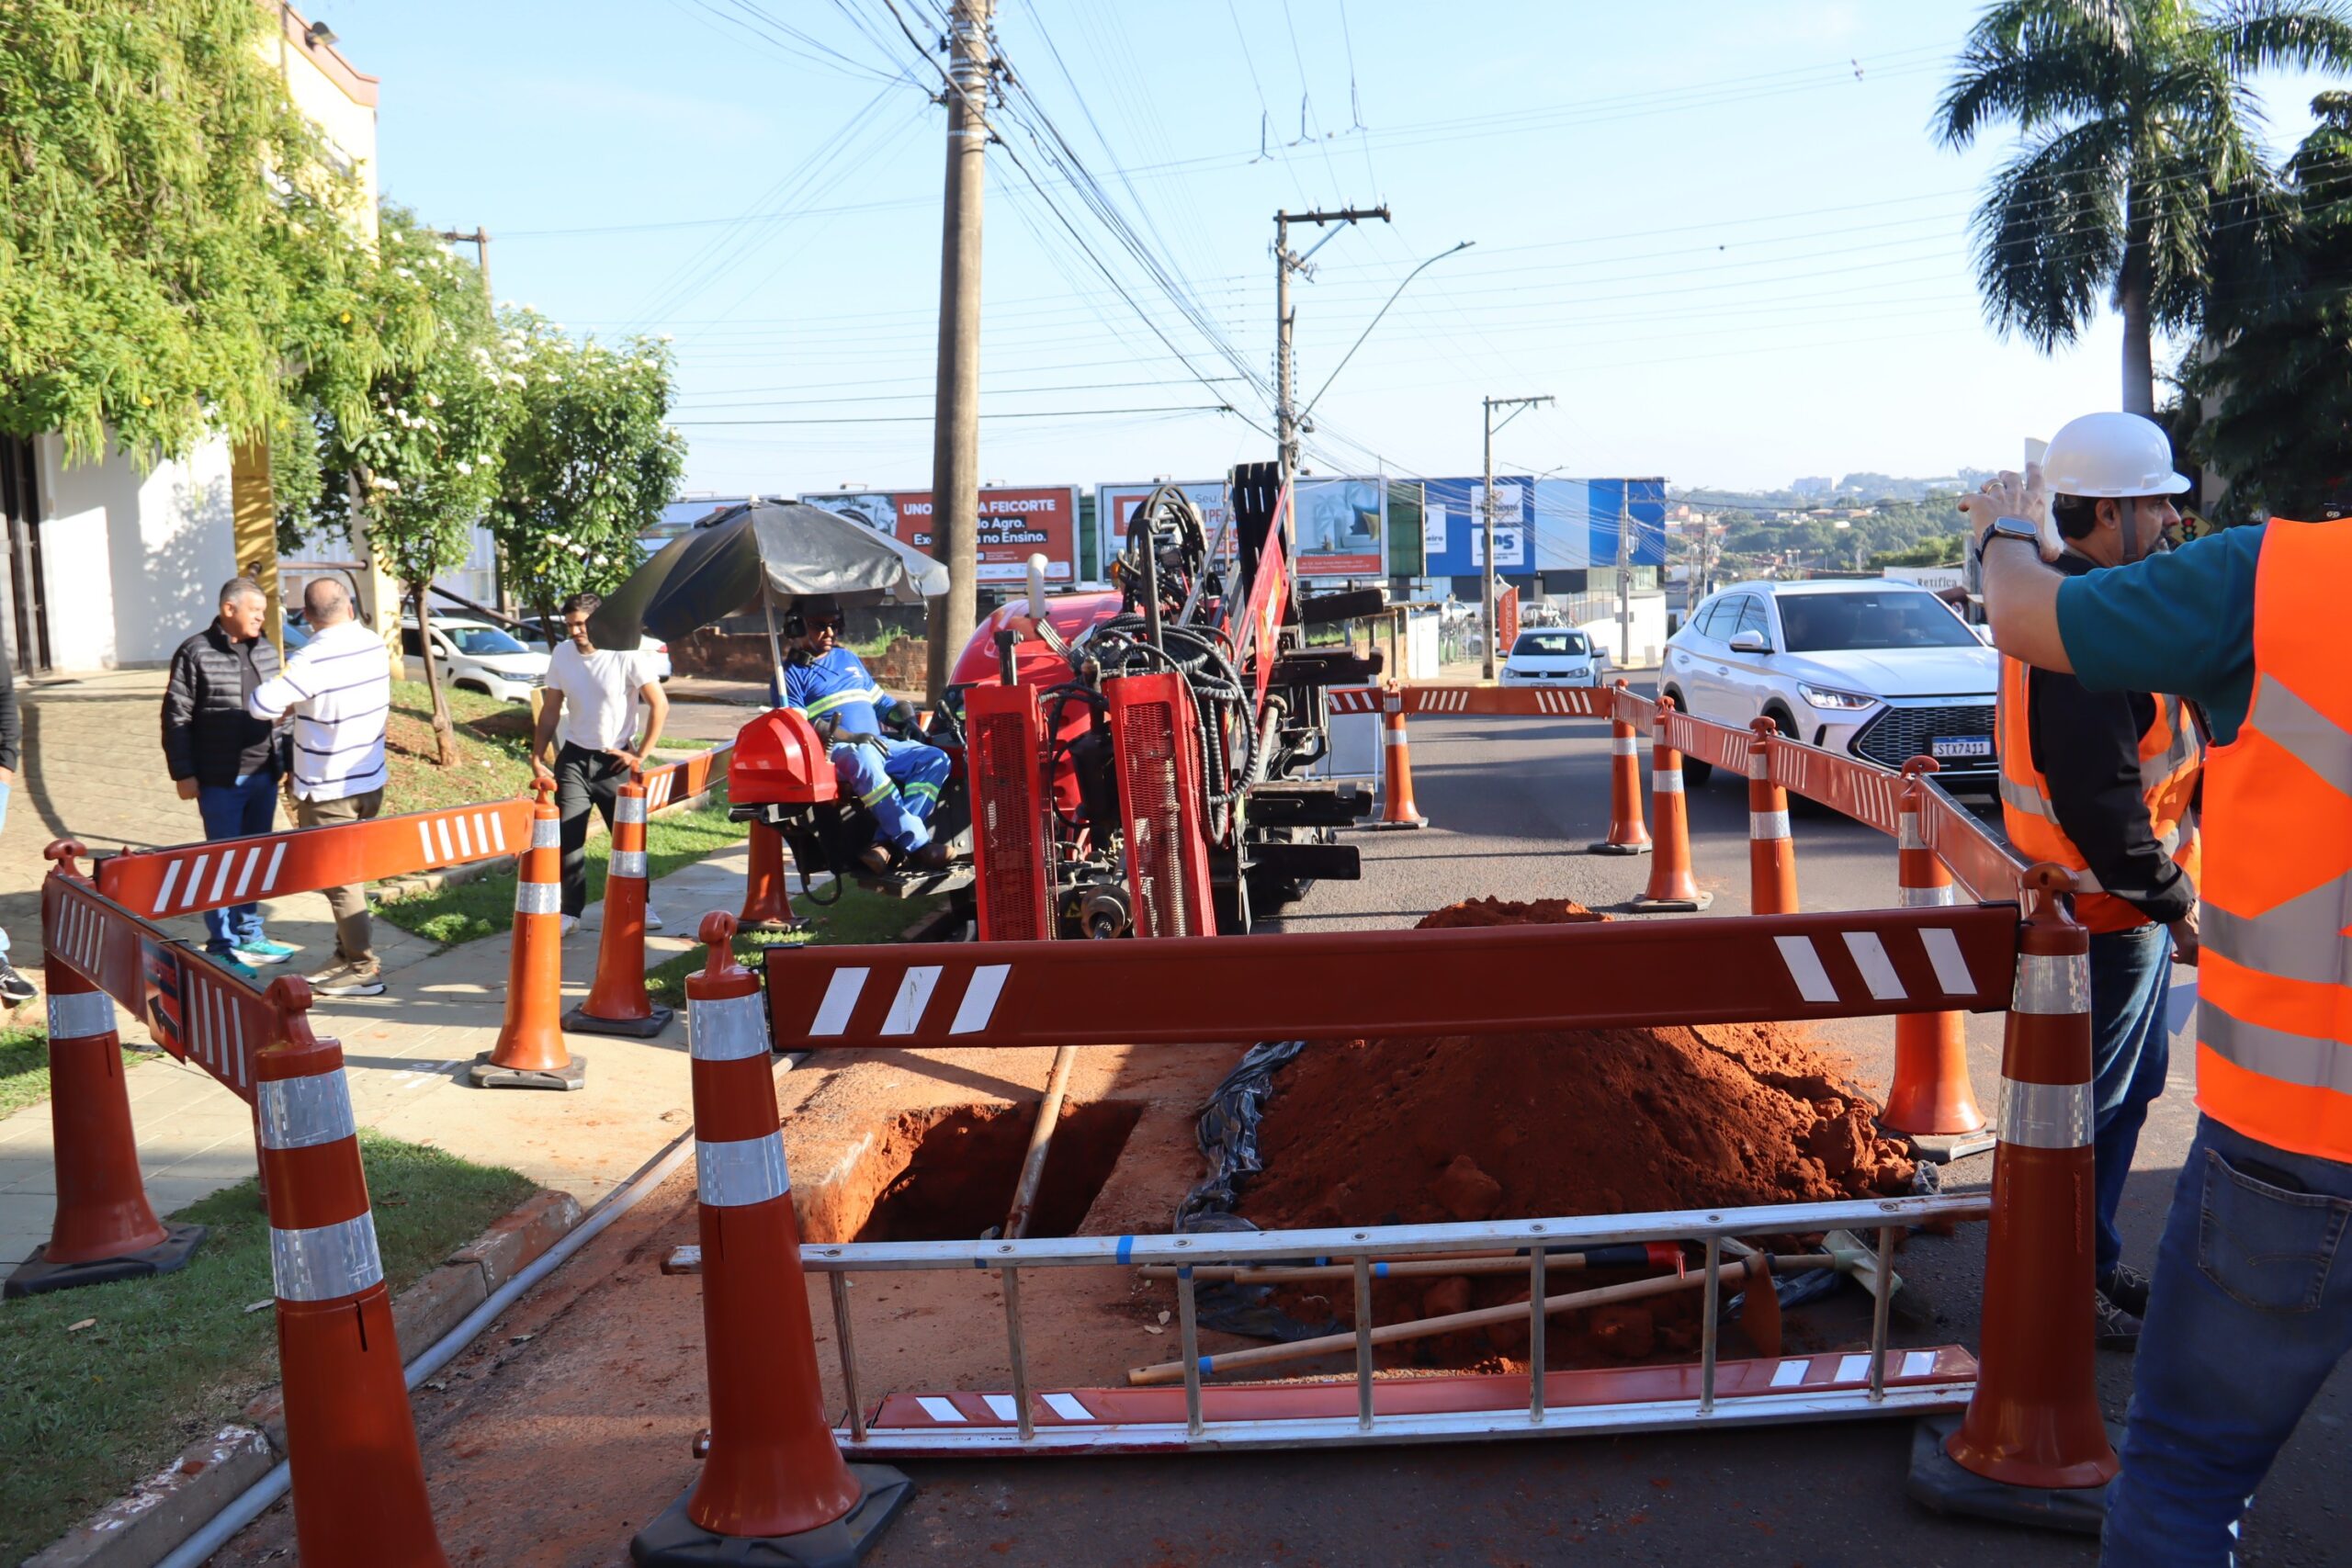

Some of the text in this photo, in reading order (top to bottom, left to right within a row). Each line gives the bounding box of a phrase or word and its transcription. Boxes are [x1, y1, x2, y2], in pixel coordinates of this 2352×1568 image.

[989, 500, 1056, 513] FEICORTE
[991, 517, 1025, 531] Agro.
[983, 531, 1046, 544] no Ensino.
